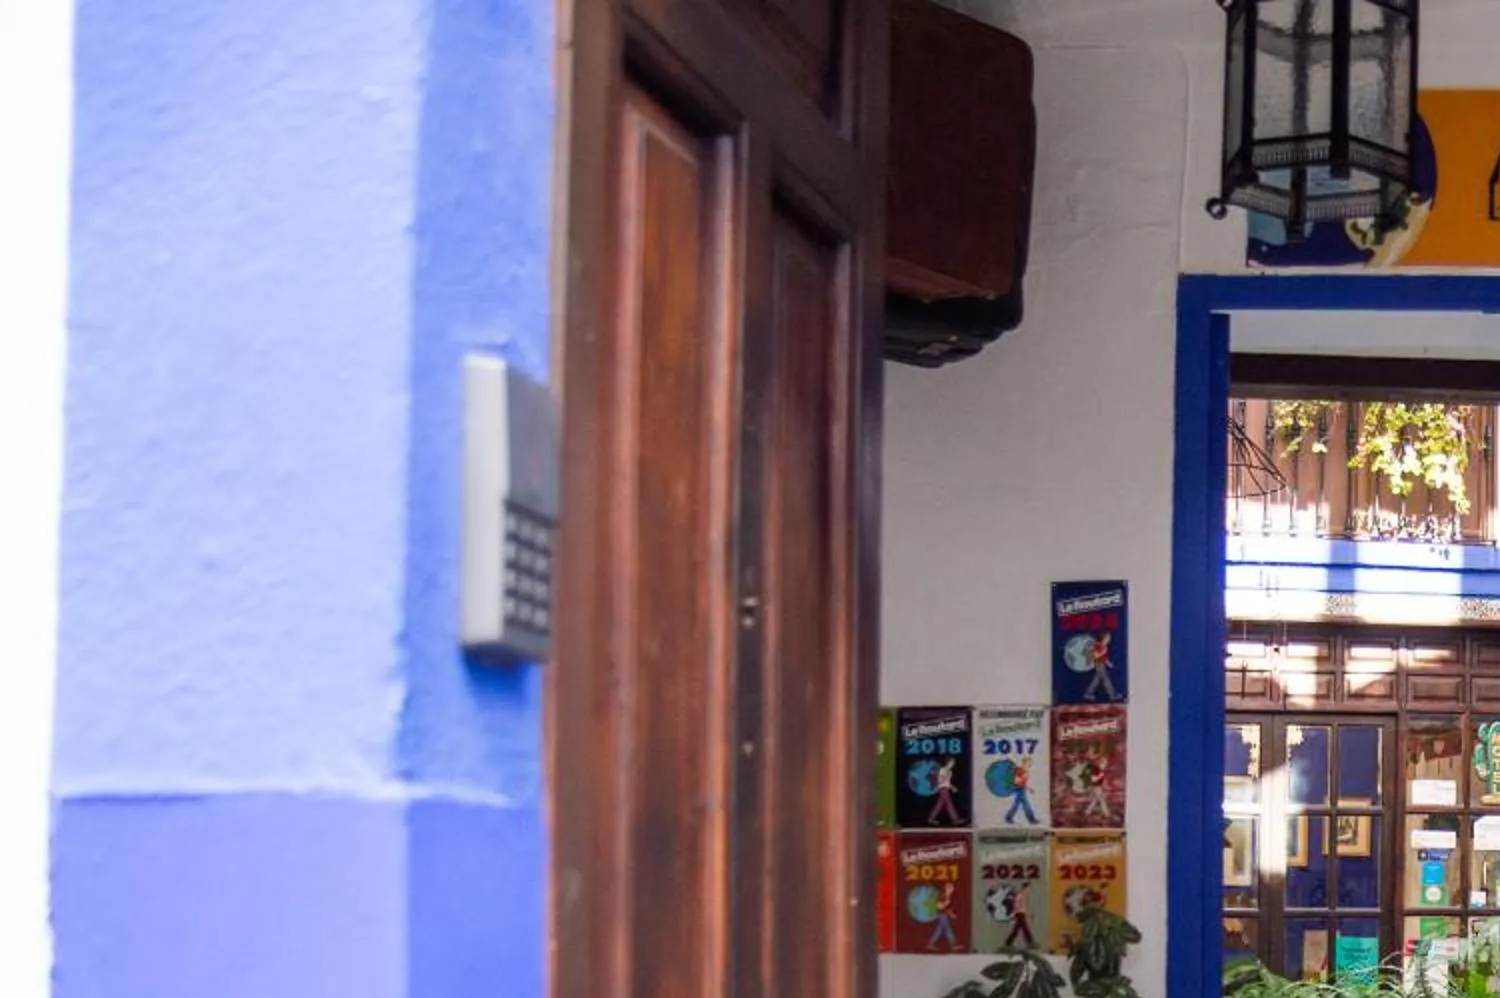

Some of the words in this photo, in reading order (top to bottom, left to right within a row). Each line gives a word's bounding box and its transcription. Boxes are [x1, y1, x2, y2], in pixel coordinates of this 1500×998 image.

[905, 738, 962, 755] 2018
[983, 738, 1040, 755] 2017
[906, 863, 960, 881] 2021
[982, 864, 1041, 880] 2022
[1059, 864, 1117, 880] 2023
